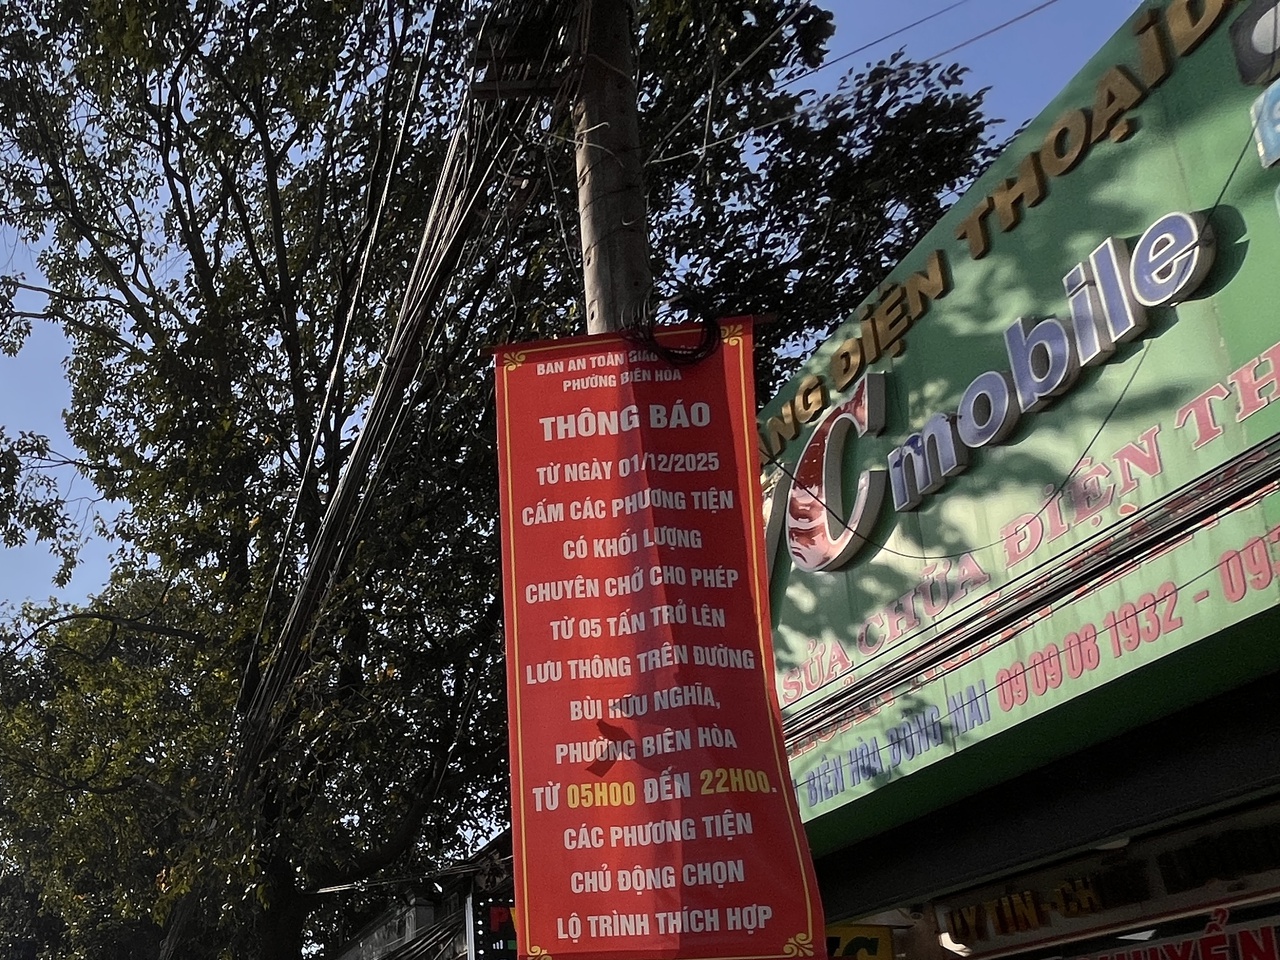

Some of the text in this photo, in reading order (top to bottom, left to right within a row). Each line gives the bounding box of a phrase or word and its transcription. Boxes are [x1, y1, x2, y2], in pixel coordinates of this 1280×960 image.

[536, 361, 564, 376] BAN
[567, 358, 587, 372] AN
[590, 351, 625, 369] TOÀN
[562, 367, 682, 392] PHƯỜNG BIÊN HÒA
[539, 400, 711, 442] THÔNG BÁO
[536, 452, 720, 486] TỪ NGÀY 01/12/2025
[521, 486, 734, 527] CẤM CÁC PHƯƠNG TIỆN
[562, 528, 702, 560] CÓ KHỐI LƯỢNG
[525, 565, 739, 604] CHUYÊN CHỞ CHO PHÉP
[549, 599, 726, 641] TỪ 05 TẤN TRỞ LÊN
[780, 638, 854, 705] SỬA
[856, 552, 991, 656] CHỮA
[526, 641, 755, 685] LƯU THÔNG TRÊN ĐƯỜNG
[569, 681, 722, 721] BÙI HỮU NGHĨA,
[806, 753, 846, 808] BIÊN
[946, 679, 992, 738] NAI
[1103, 581, 1184, 659] 1932
[555, 722, 738, 765] PHƯỜNG BIÊN HÒA
[532, 781, 561, 812] TỪ
[566, 781, 636, 809] 05H00
[643, 765, 692, 804] ĐẾN
[563, 809, 754, 851] CÁC PHƯƠNG TIỆN
[570, 859, 745, 896] CHỦ ĐỘNG CHỌN
[556, 903, 773, 944] LỘ TRÌNH THÍCH HỢP
